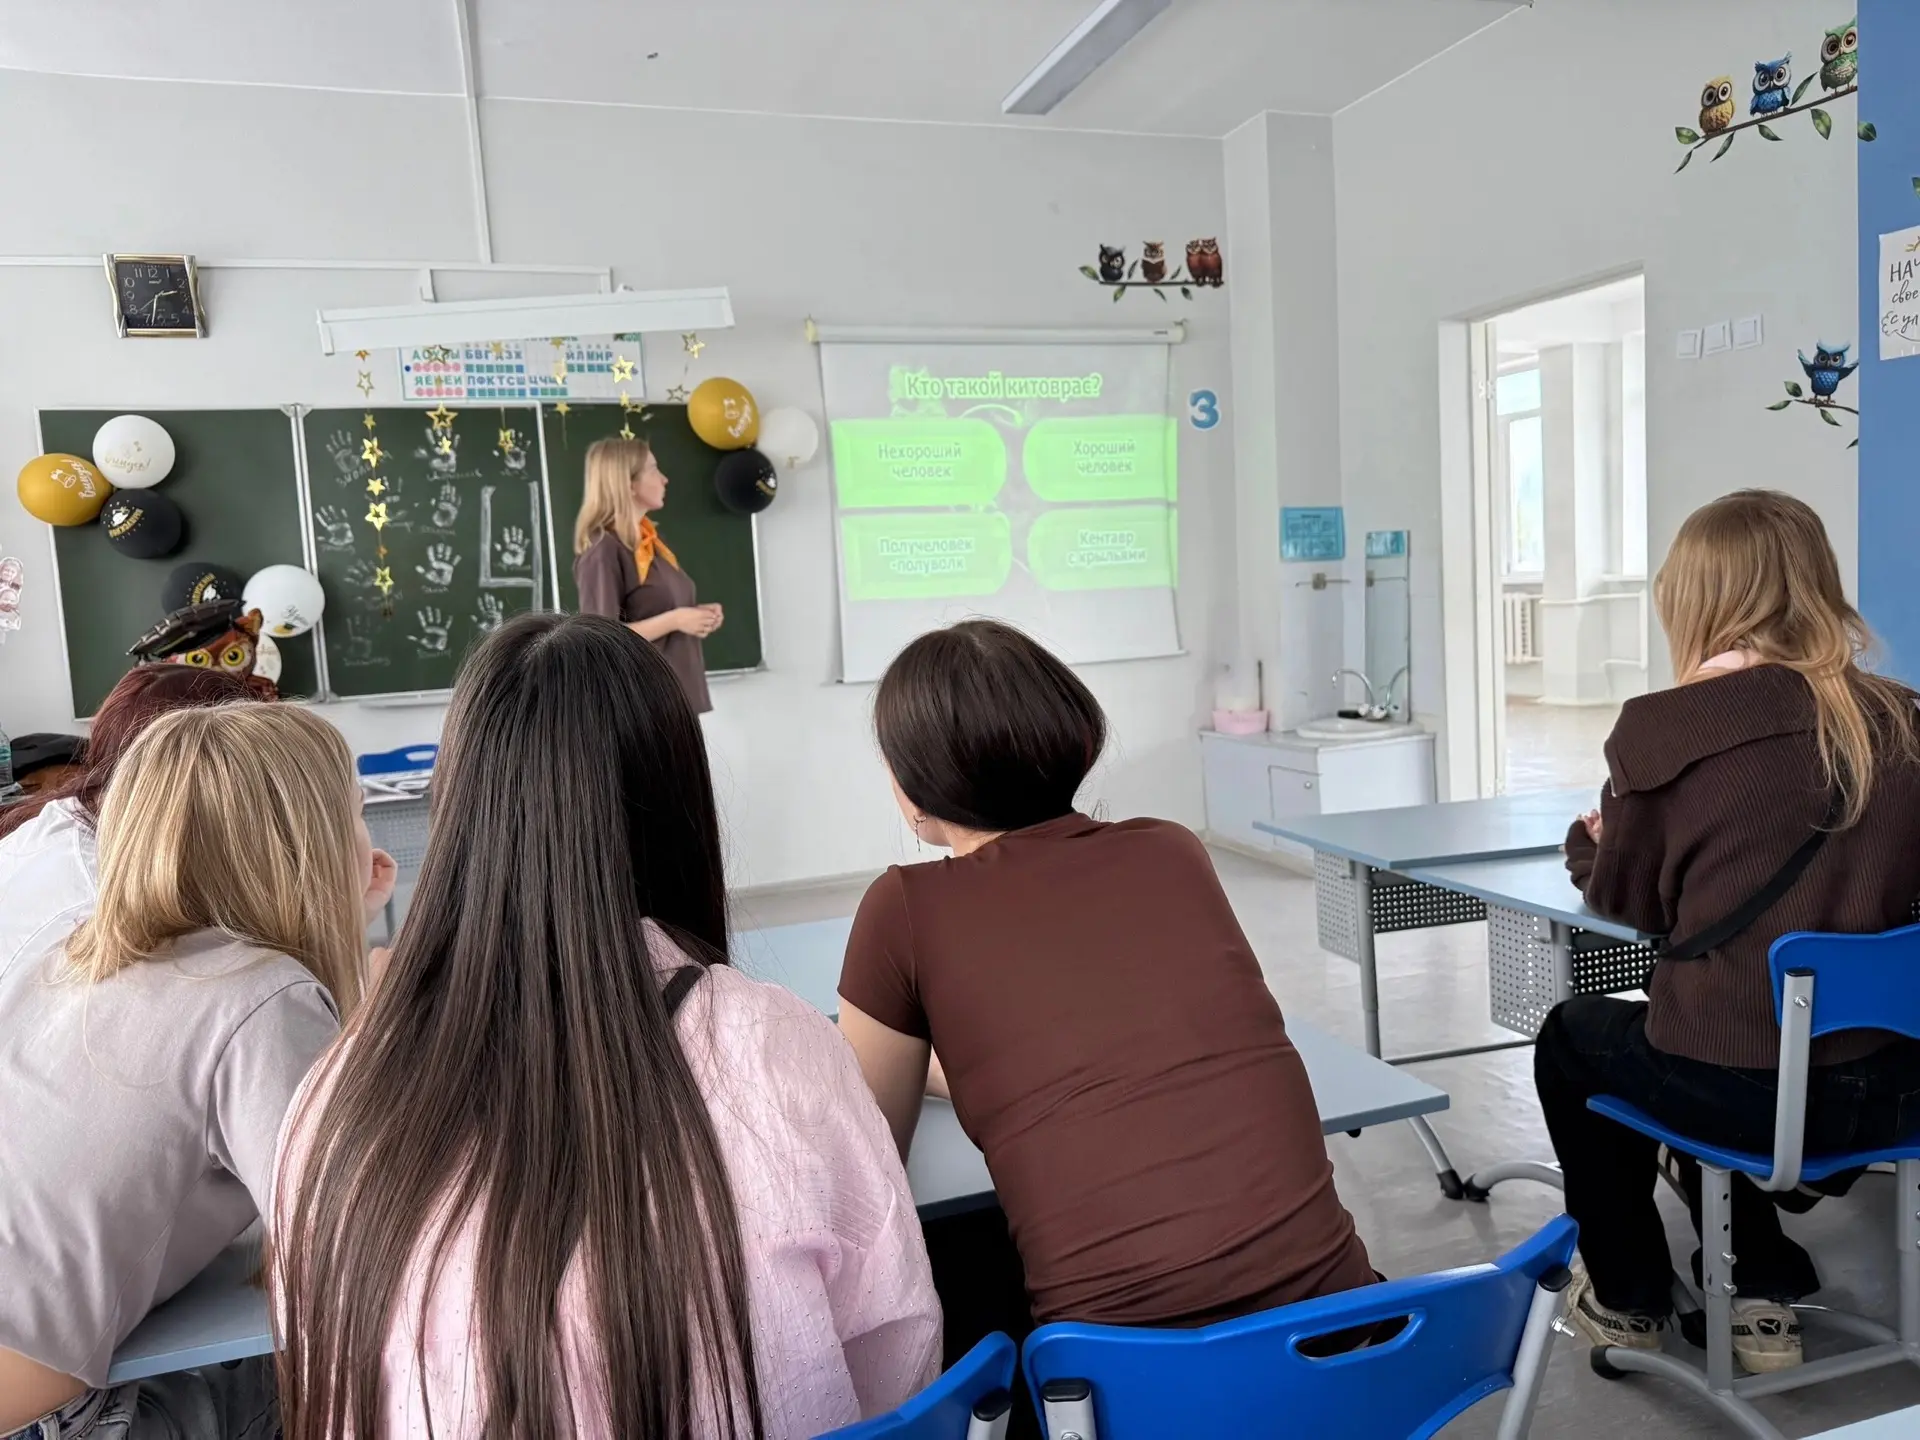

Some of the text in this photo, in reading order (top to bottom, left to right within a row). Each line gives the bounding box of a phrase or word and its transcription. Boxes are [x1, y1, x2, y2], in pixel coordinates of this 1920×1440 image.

[147, 268, 158, 278] 12
[907, 373, 1102, 402] Кто такой китоврас?
[1190, 389, 1219, 429] 3
[878, 442, 962, 462] Нехороший
[1073, 438, 1135, 459] Хороший
[892, 466, 951, 478] человек
[1076, 461, 1132, 473] человек
[880, 538, 973, 555] Получеловек
[1080, 531, 1134, 547] Кентавр
[1080, 549, 1147, 566] крыльями
